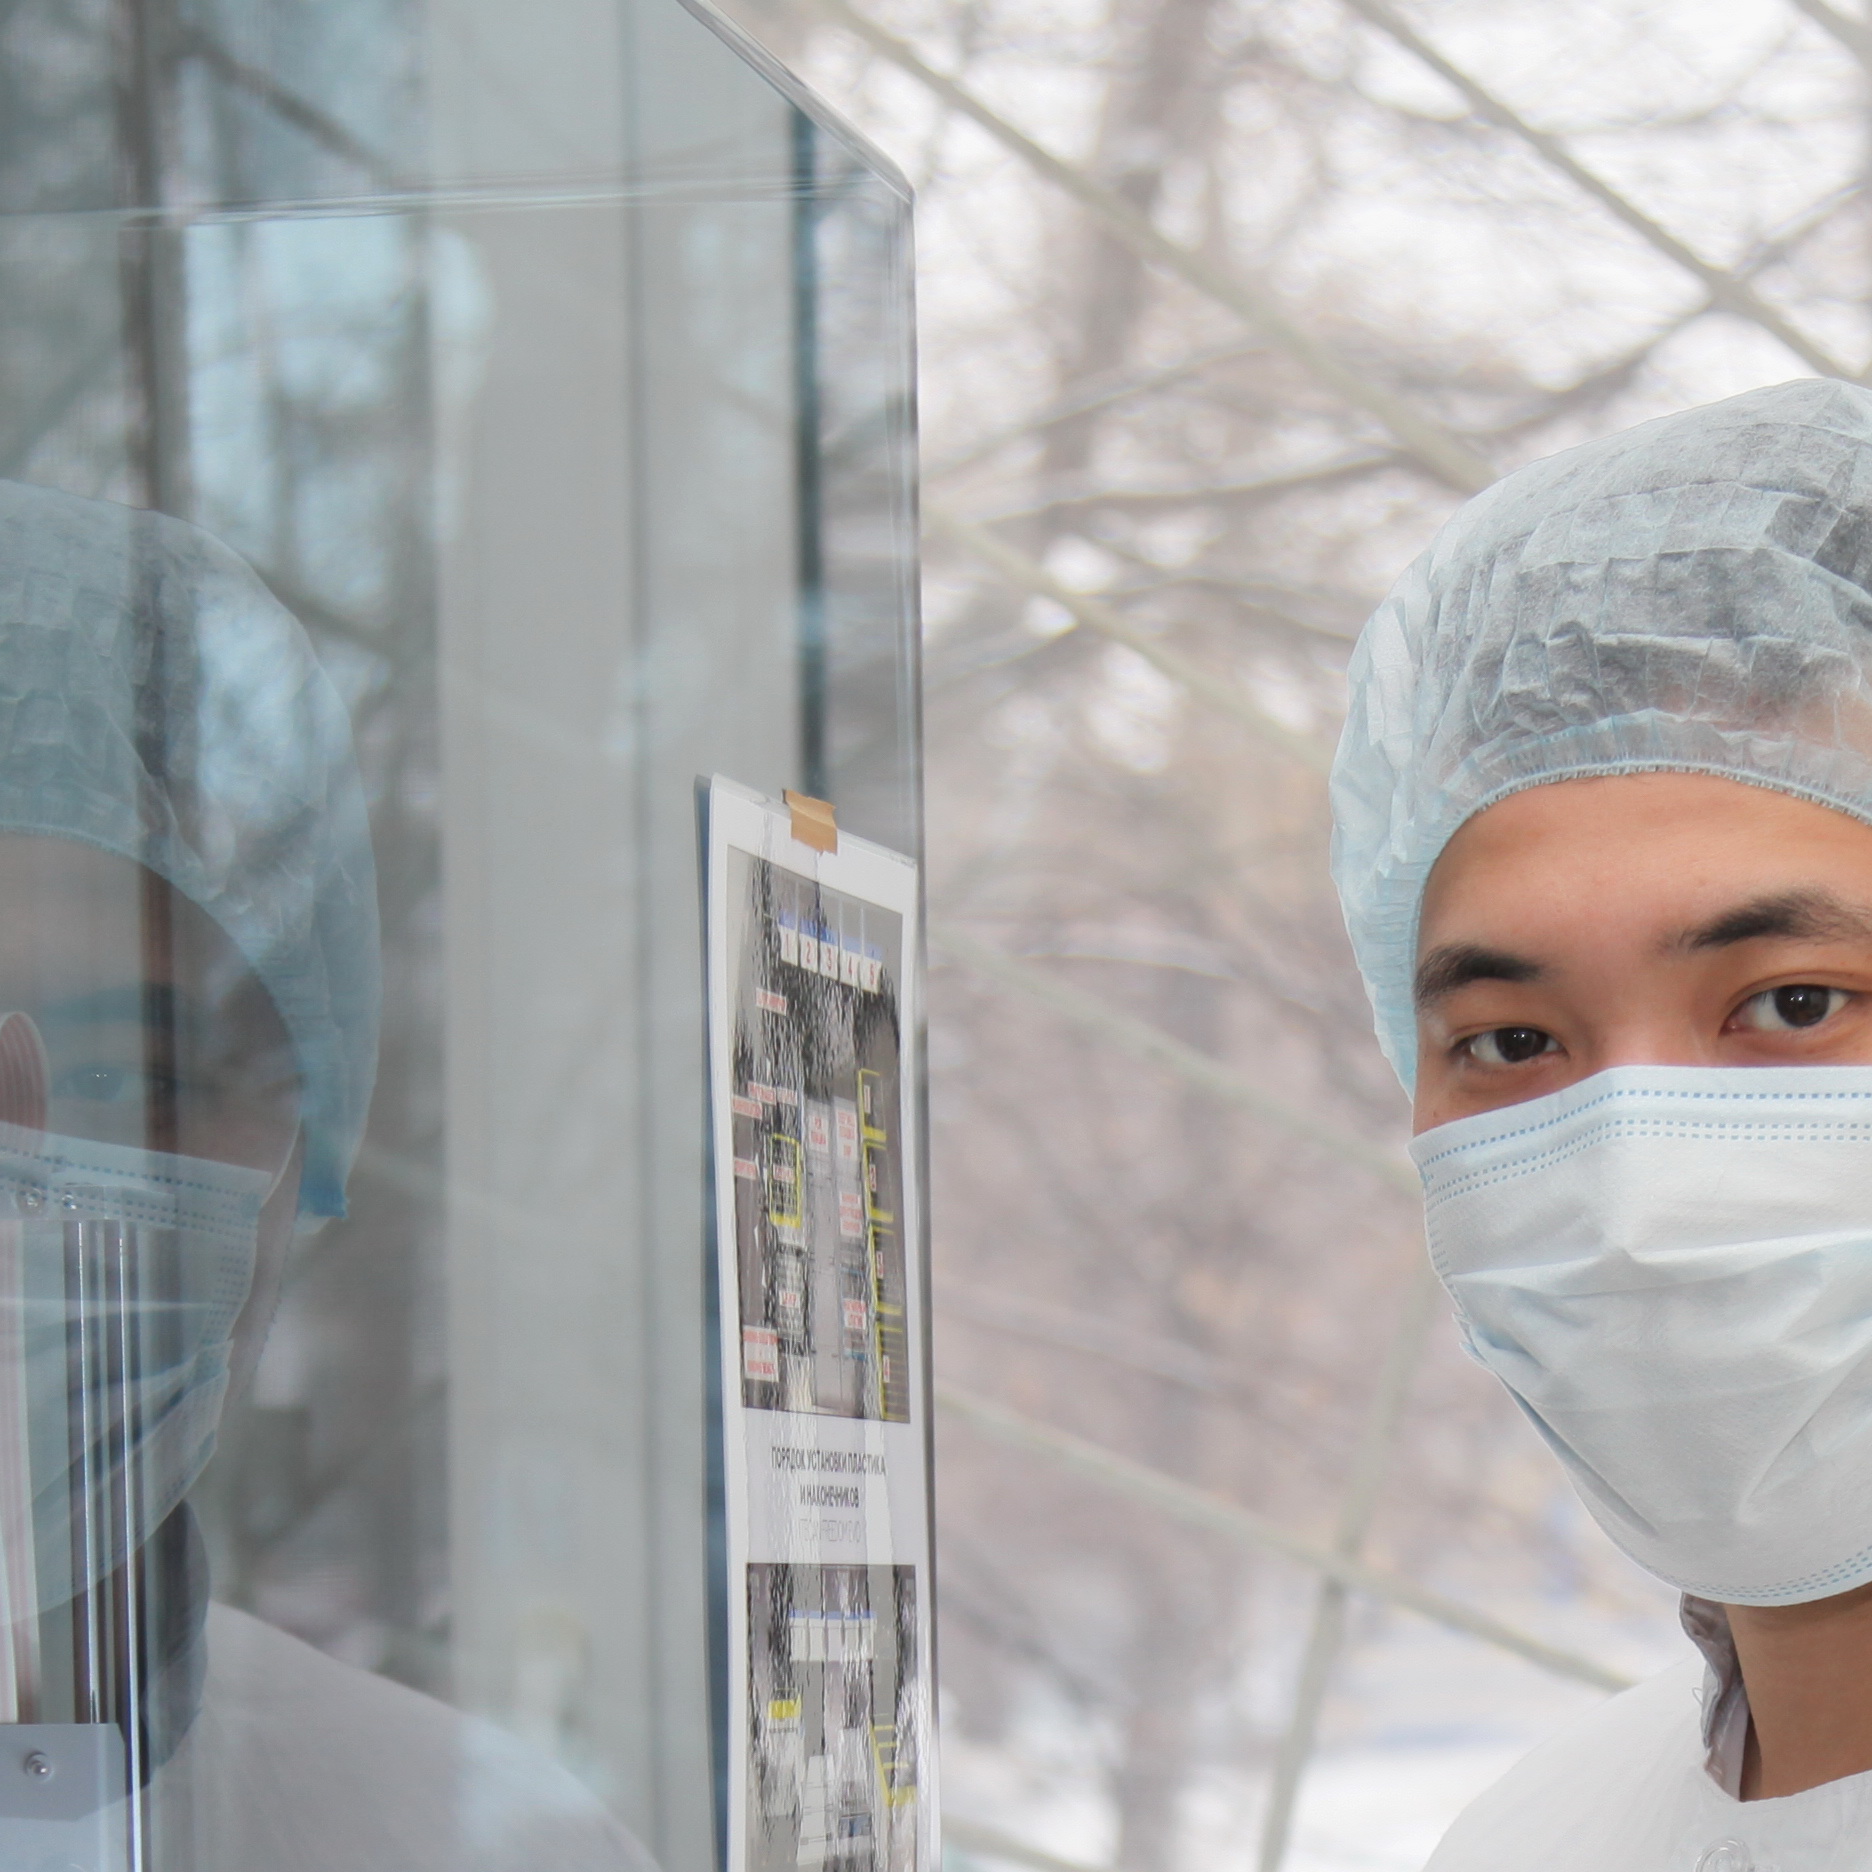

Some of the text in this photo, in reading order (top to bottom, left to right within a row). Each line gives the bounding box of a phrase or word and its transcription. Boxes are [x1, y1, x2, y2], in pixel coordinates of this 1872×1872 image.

[771, 1446, 886, 1476] ПОРЯДОК УСТАНОВКИ ПЛАСТИКА
[807, 1484, 859, 1508] НАКОНЕЧНИКОВ
